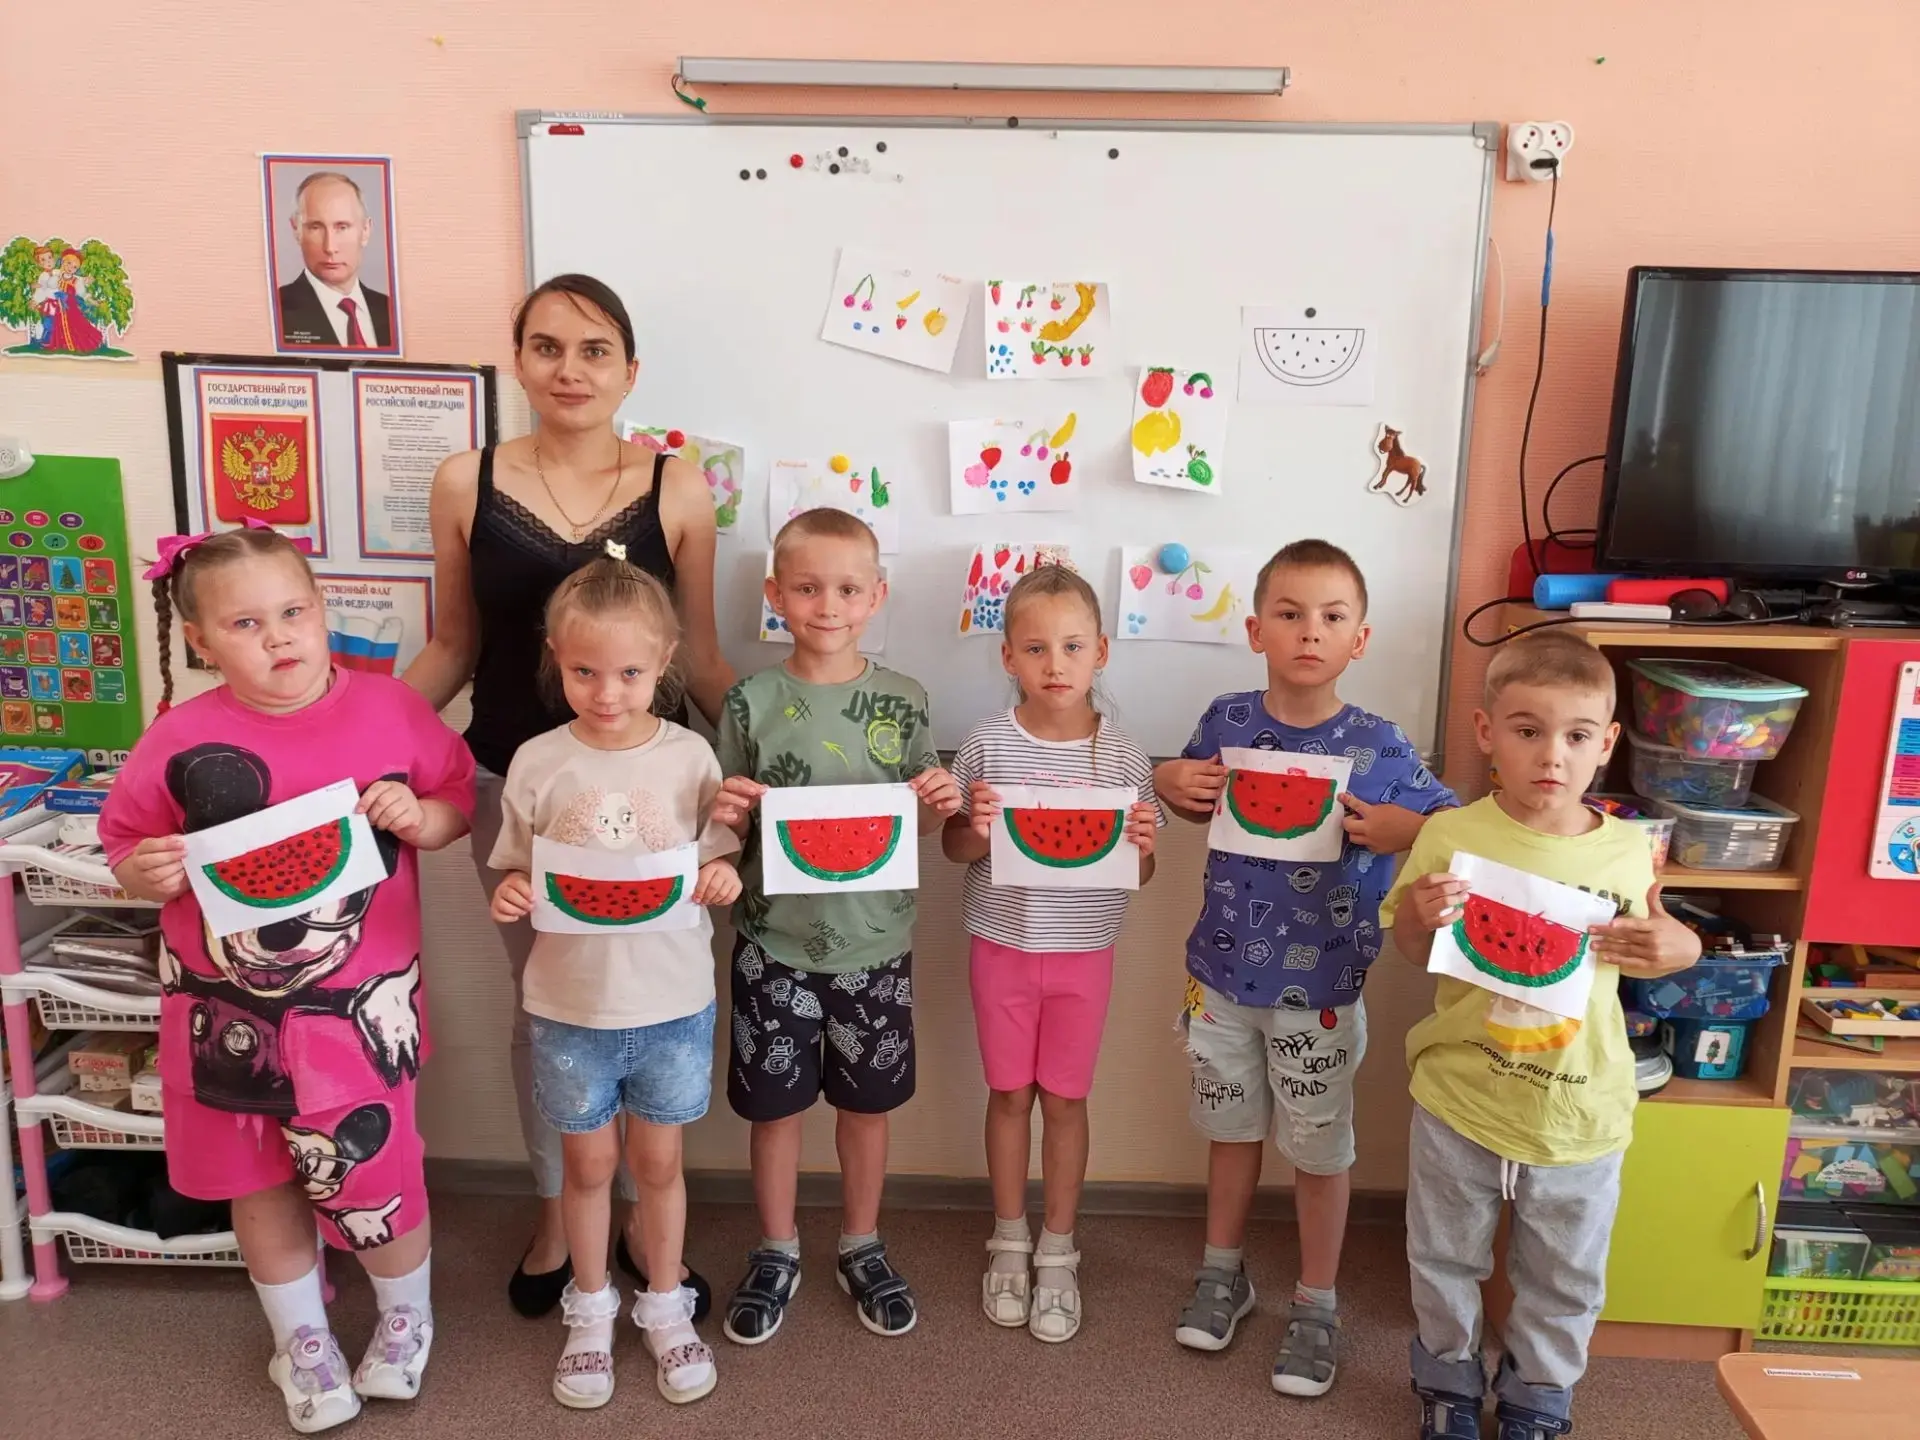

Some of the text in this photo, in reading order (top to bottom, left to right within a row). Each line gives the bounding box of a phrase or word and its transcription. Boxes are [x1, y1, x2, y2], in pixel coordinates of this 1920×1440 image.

[207, 382, 307, 394] ГОСУДАРСТВЕННЫЙ ГЕРБ
[365, 384, 465, 397] ГОСУДАРСТВЕННЫЙ ГИМН
[208, 395, 308, 409] РОССИЙСКОЙ ФЕДЕРАЦИИ
[365, 396, 465, 411] РОССИЙСКОЙ ФЕДЕРАЦИИ
[369, 586, 393, 596] ФЛАГ
[344, 599, 394, 612] ФЕДЕРАЦИИ
[95, 752, 104, 762] 9
[113, 753, 129, 763] 10
[1327, 886, 1357, 905] HAPPY
[1282, 943, 1321, 971] 23
[1517, 1061, 1555, 1081] FRUIT
[1553, 1072, 1589, 1086] SALAD
[1527, 1077, 1551, 1092] Juice
